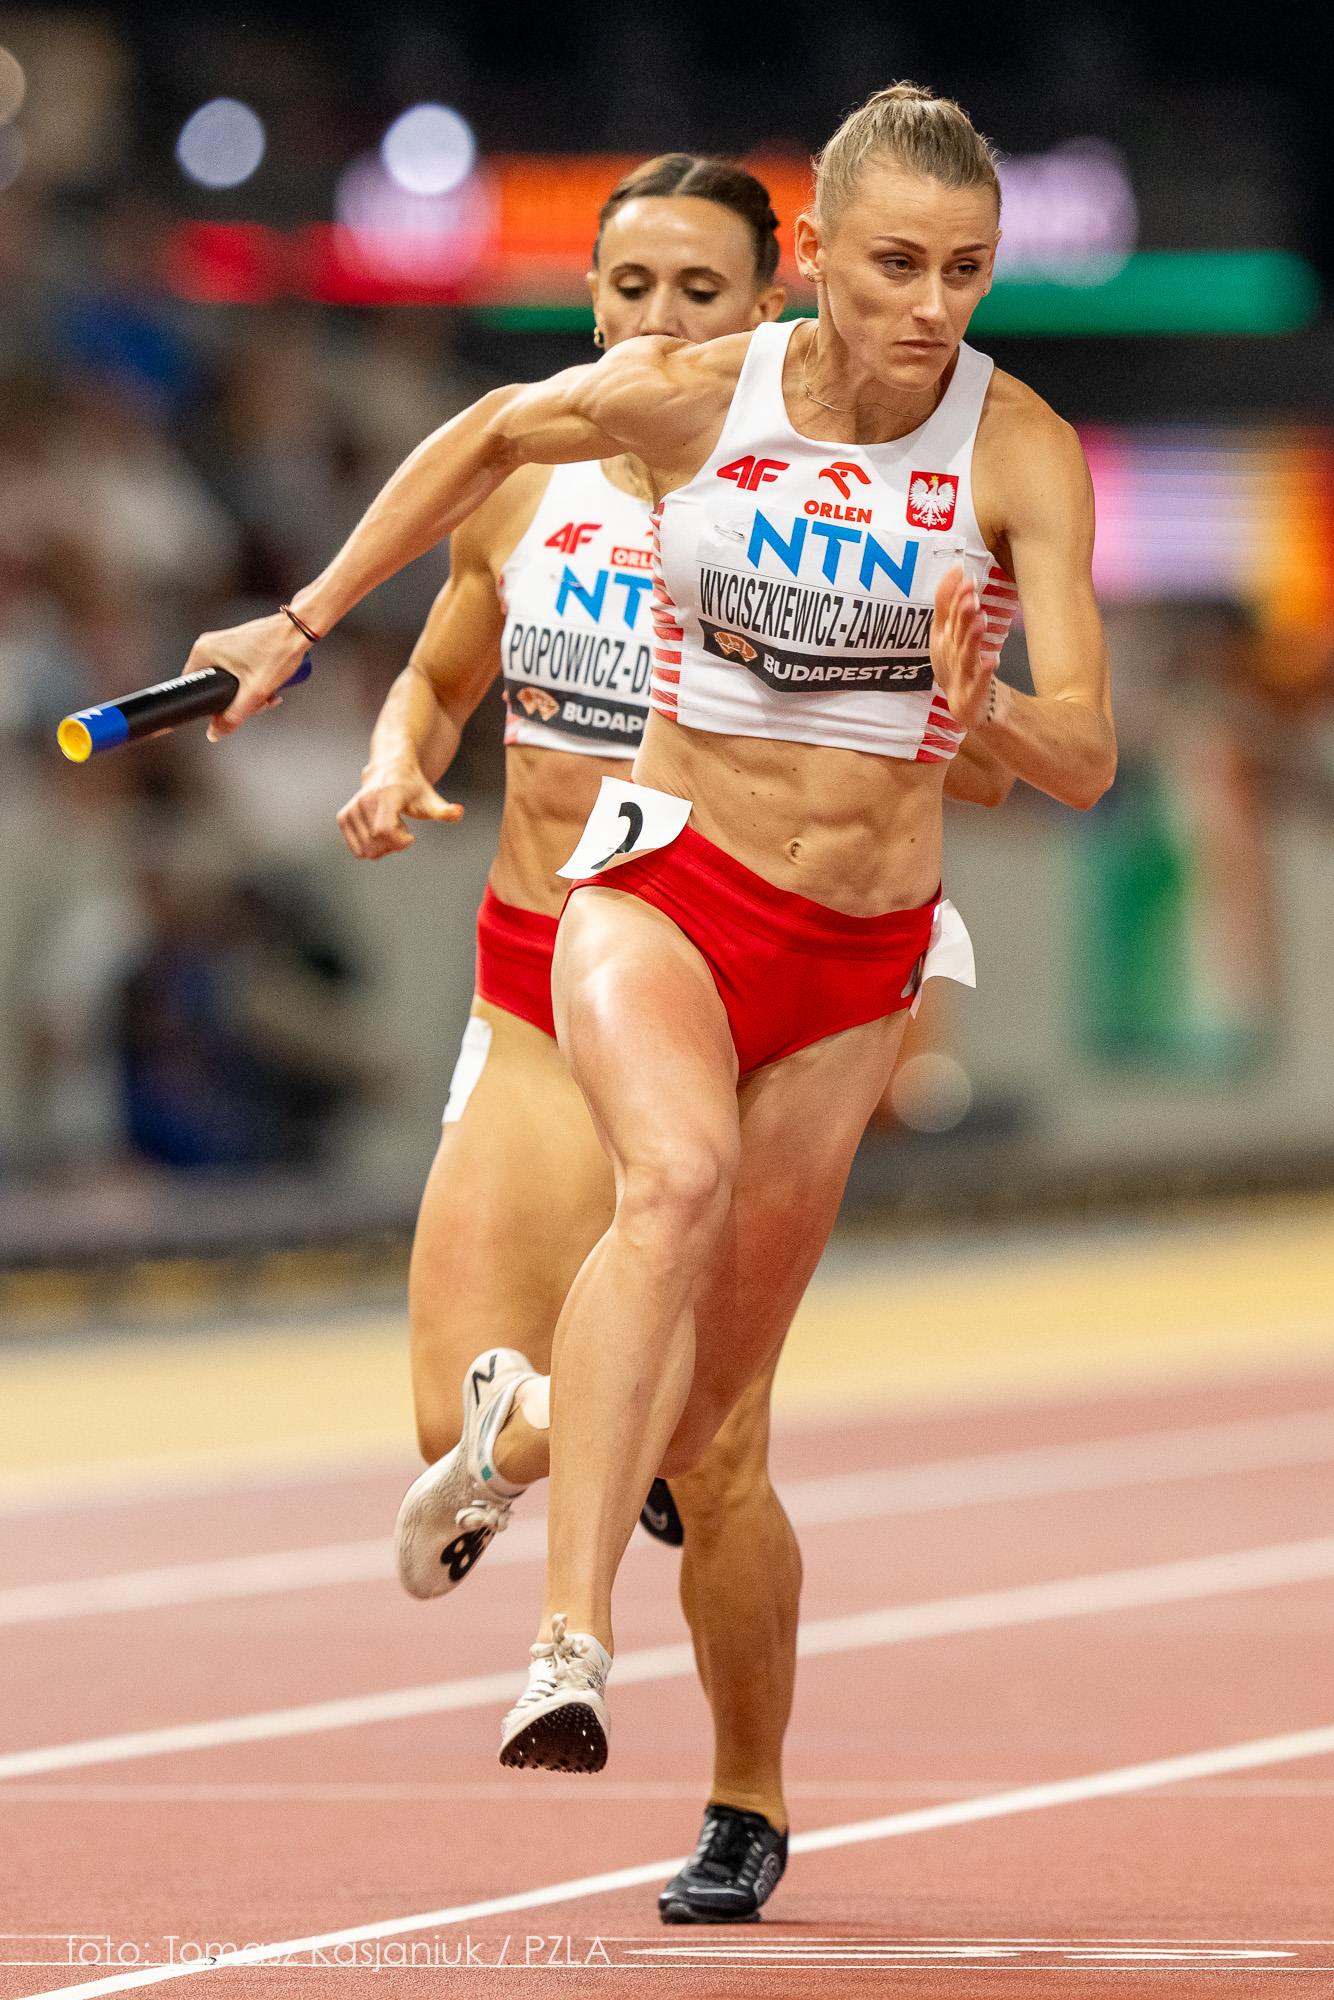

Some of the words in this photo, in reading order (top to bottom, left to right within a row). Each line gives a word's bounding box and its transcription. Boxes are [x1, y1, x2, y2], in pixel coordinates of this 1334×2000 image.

[716, 455, 790, 491] 4F
[804, 500, 872, 524] ORLEN
[544, 522, 602, 554] 4F
[747, 508, 919, 598] NTN
[509, 624, 651, 695] POPOWICZ-D
[763, 653, 888, 682] BUDAPEST
[889, 664, 919, 681] 23
